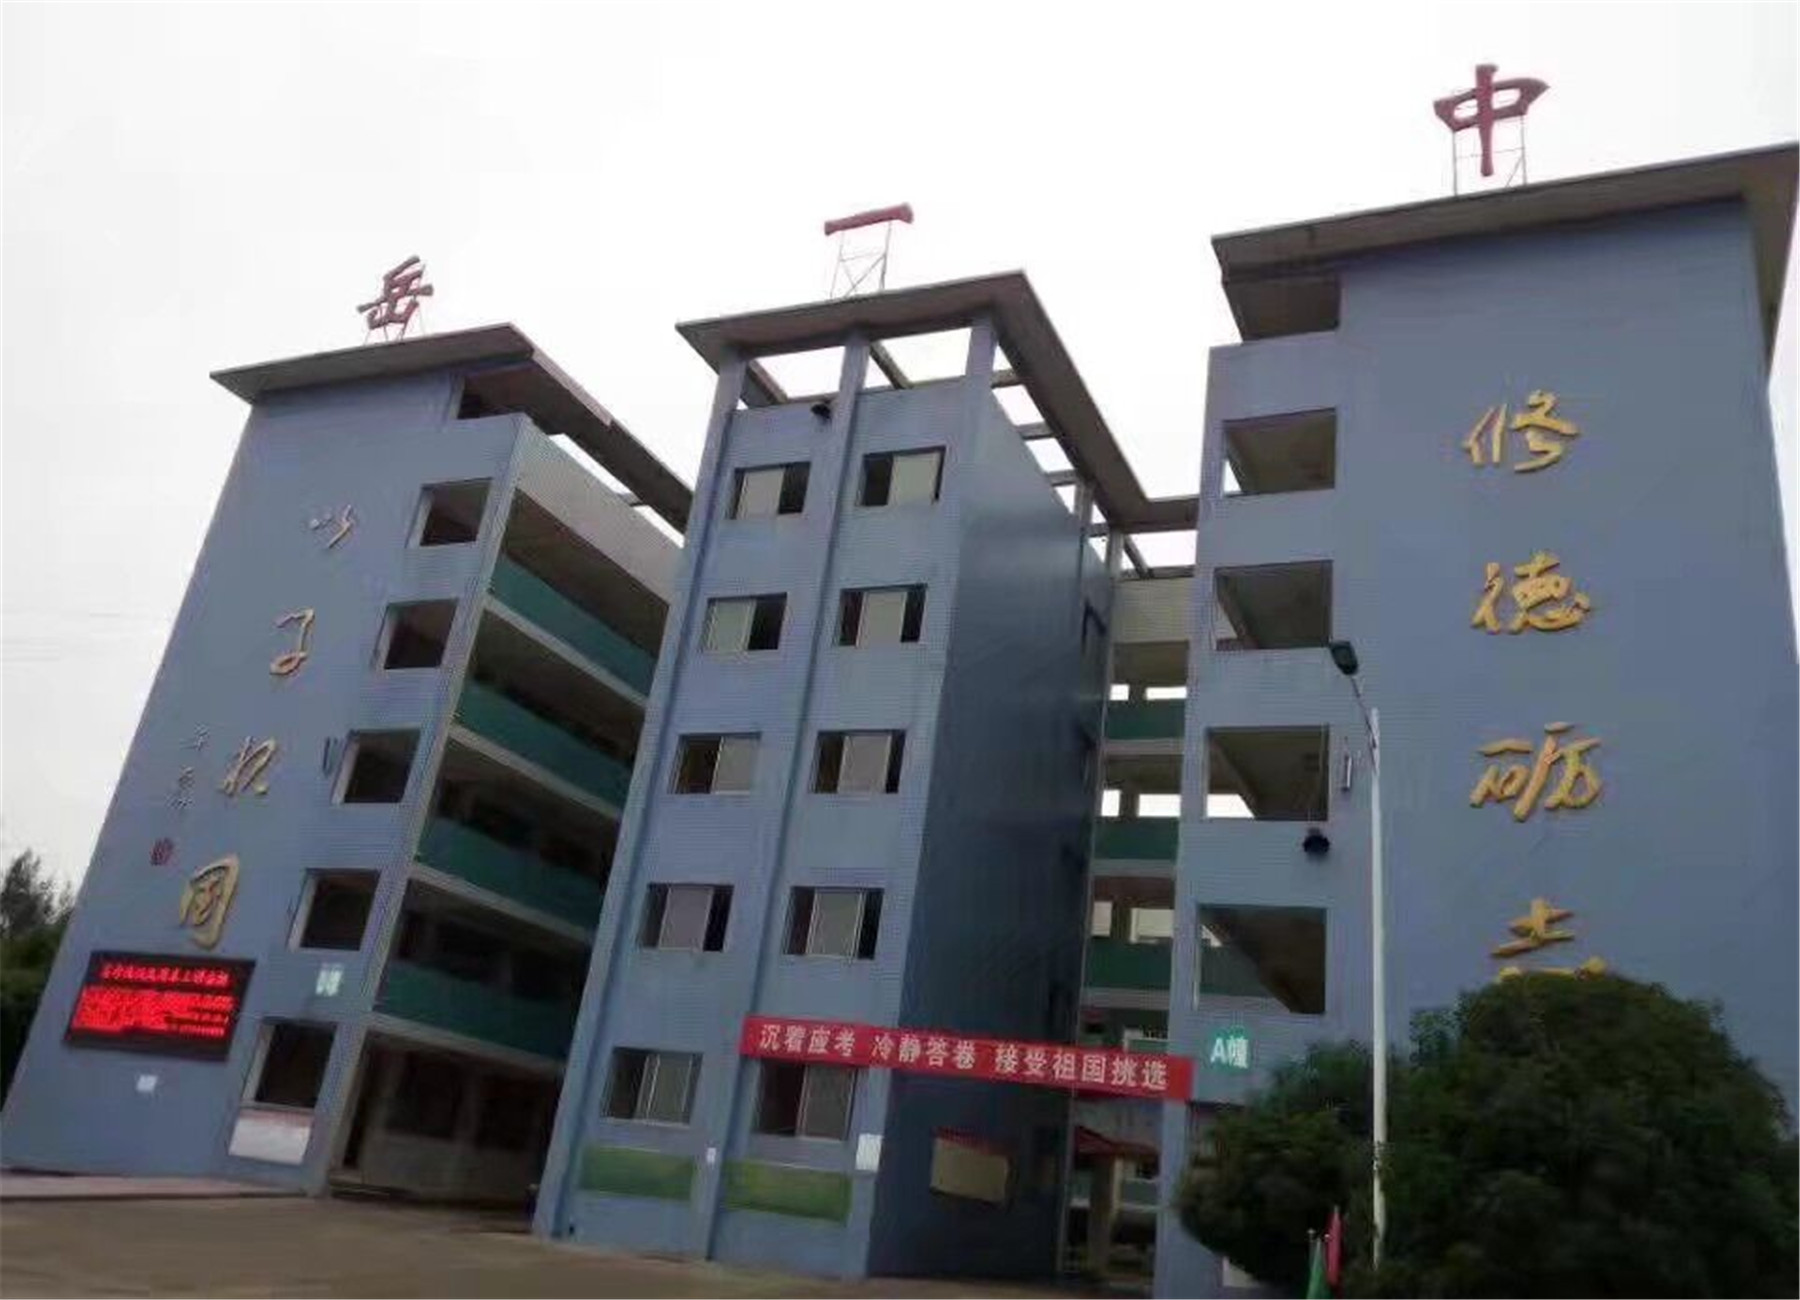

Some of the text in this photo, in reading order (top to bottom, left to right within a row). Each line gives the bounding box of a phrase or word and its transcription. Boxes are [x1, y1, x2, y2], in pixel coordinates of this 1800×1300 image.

[356, 63, 1550, 331] 岳 一 中
[758, 1022, 1169, 1091] 沉着应考 冷静答卷 接受祖国挑选
[1209, 1035, 1250, 1070] A幢
